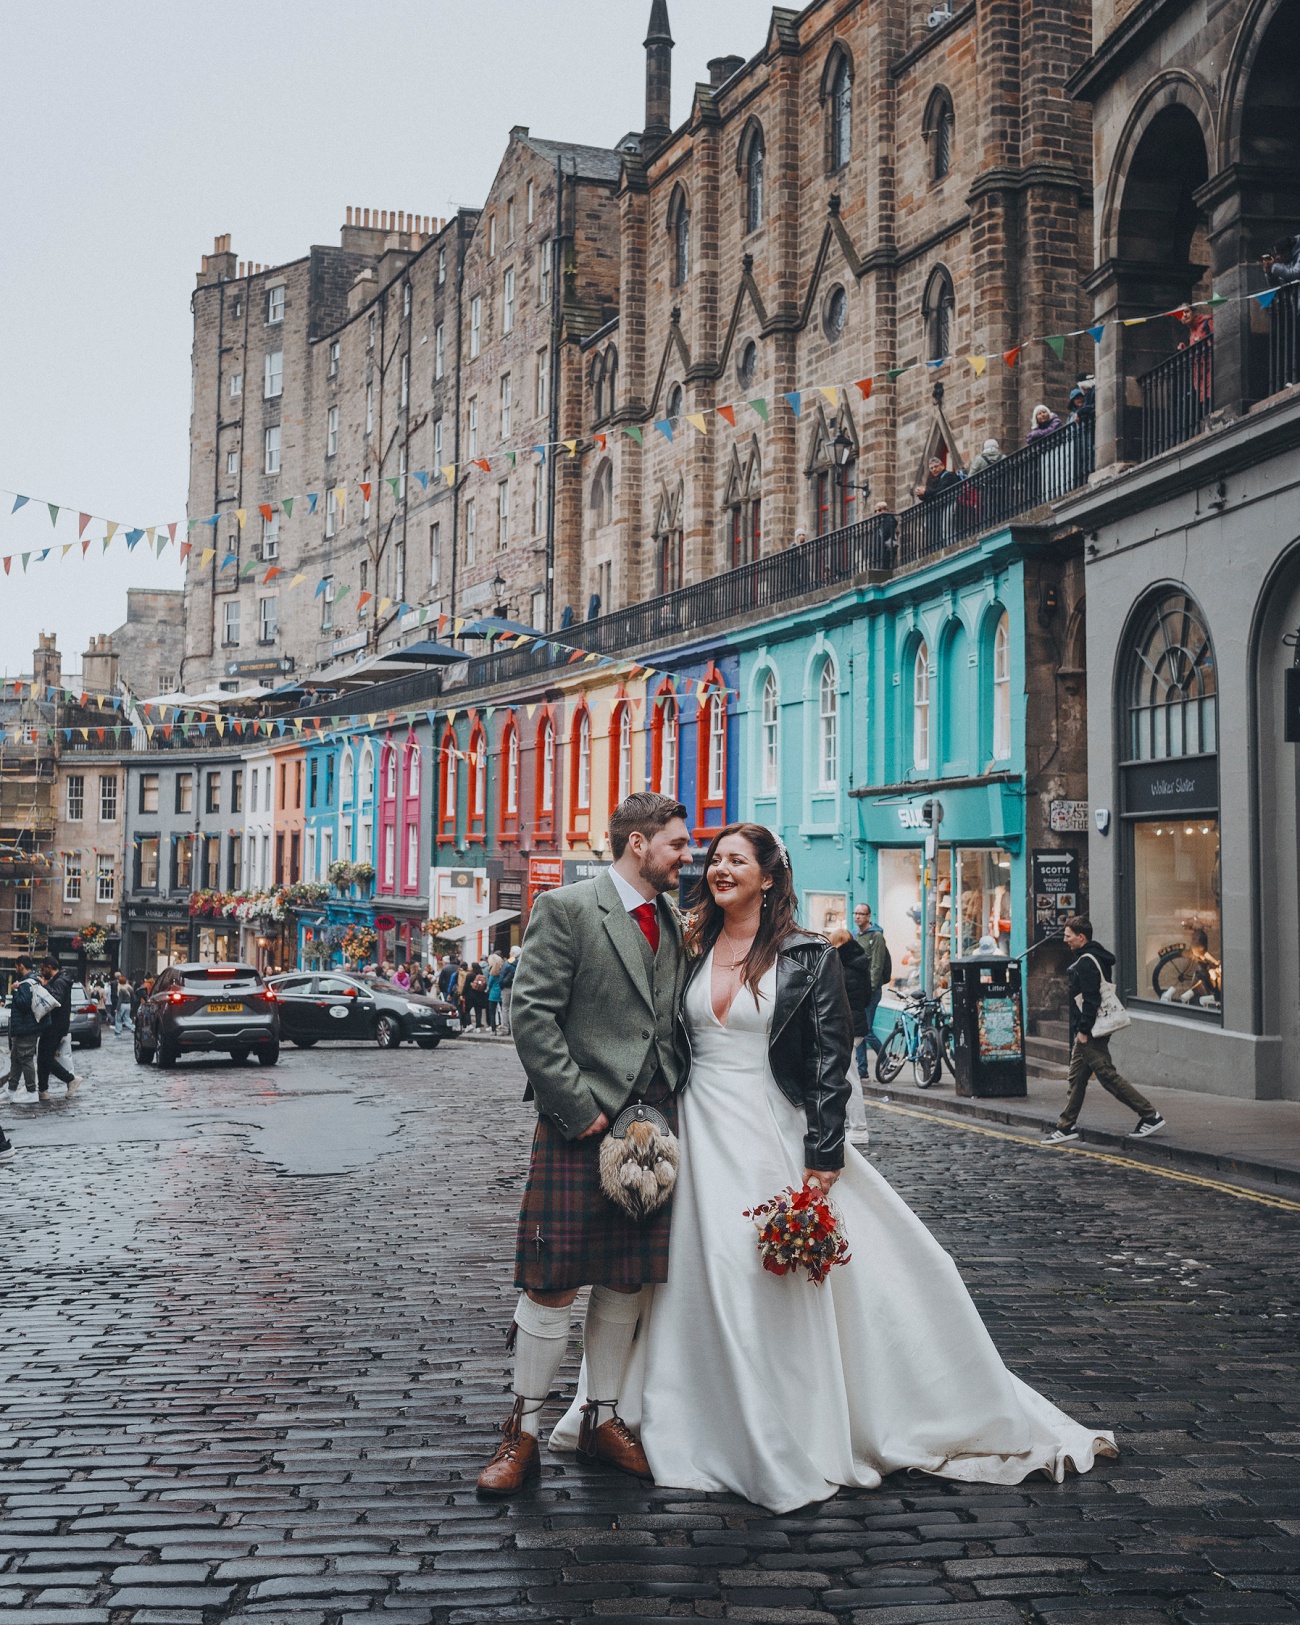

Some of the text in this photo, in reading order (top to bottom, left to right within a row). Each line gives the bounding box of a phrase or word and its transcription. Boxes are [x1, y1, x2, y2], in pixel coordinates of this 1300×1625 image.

[1150, 777, 1195, 796] Walker Slater
[575, 864, 588, 876] THE
[1040, 866, 1071, 874] SCOTTS
